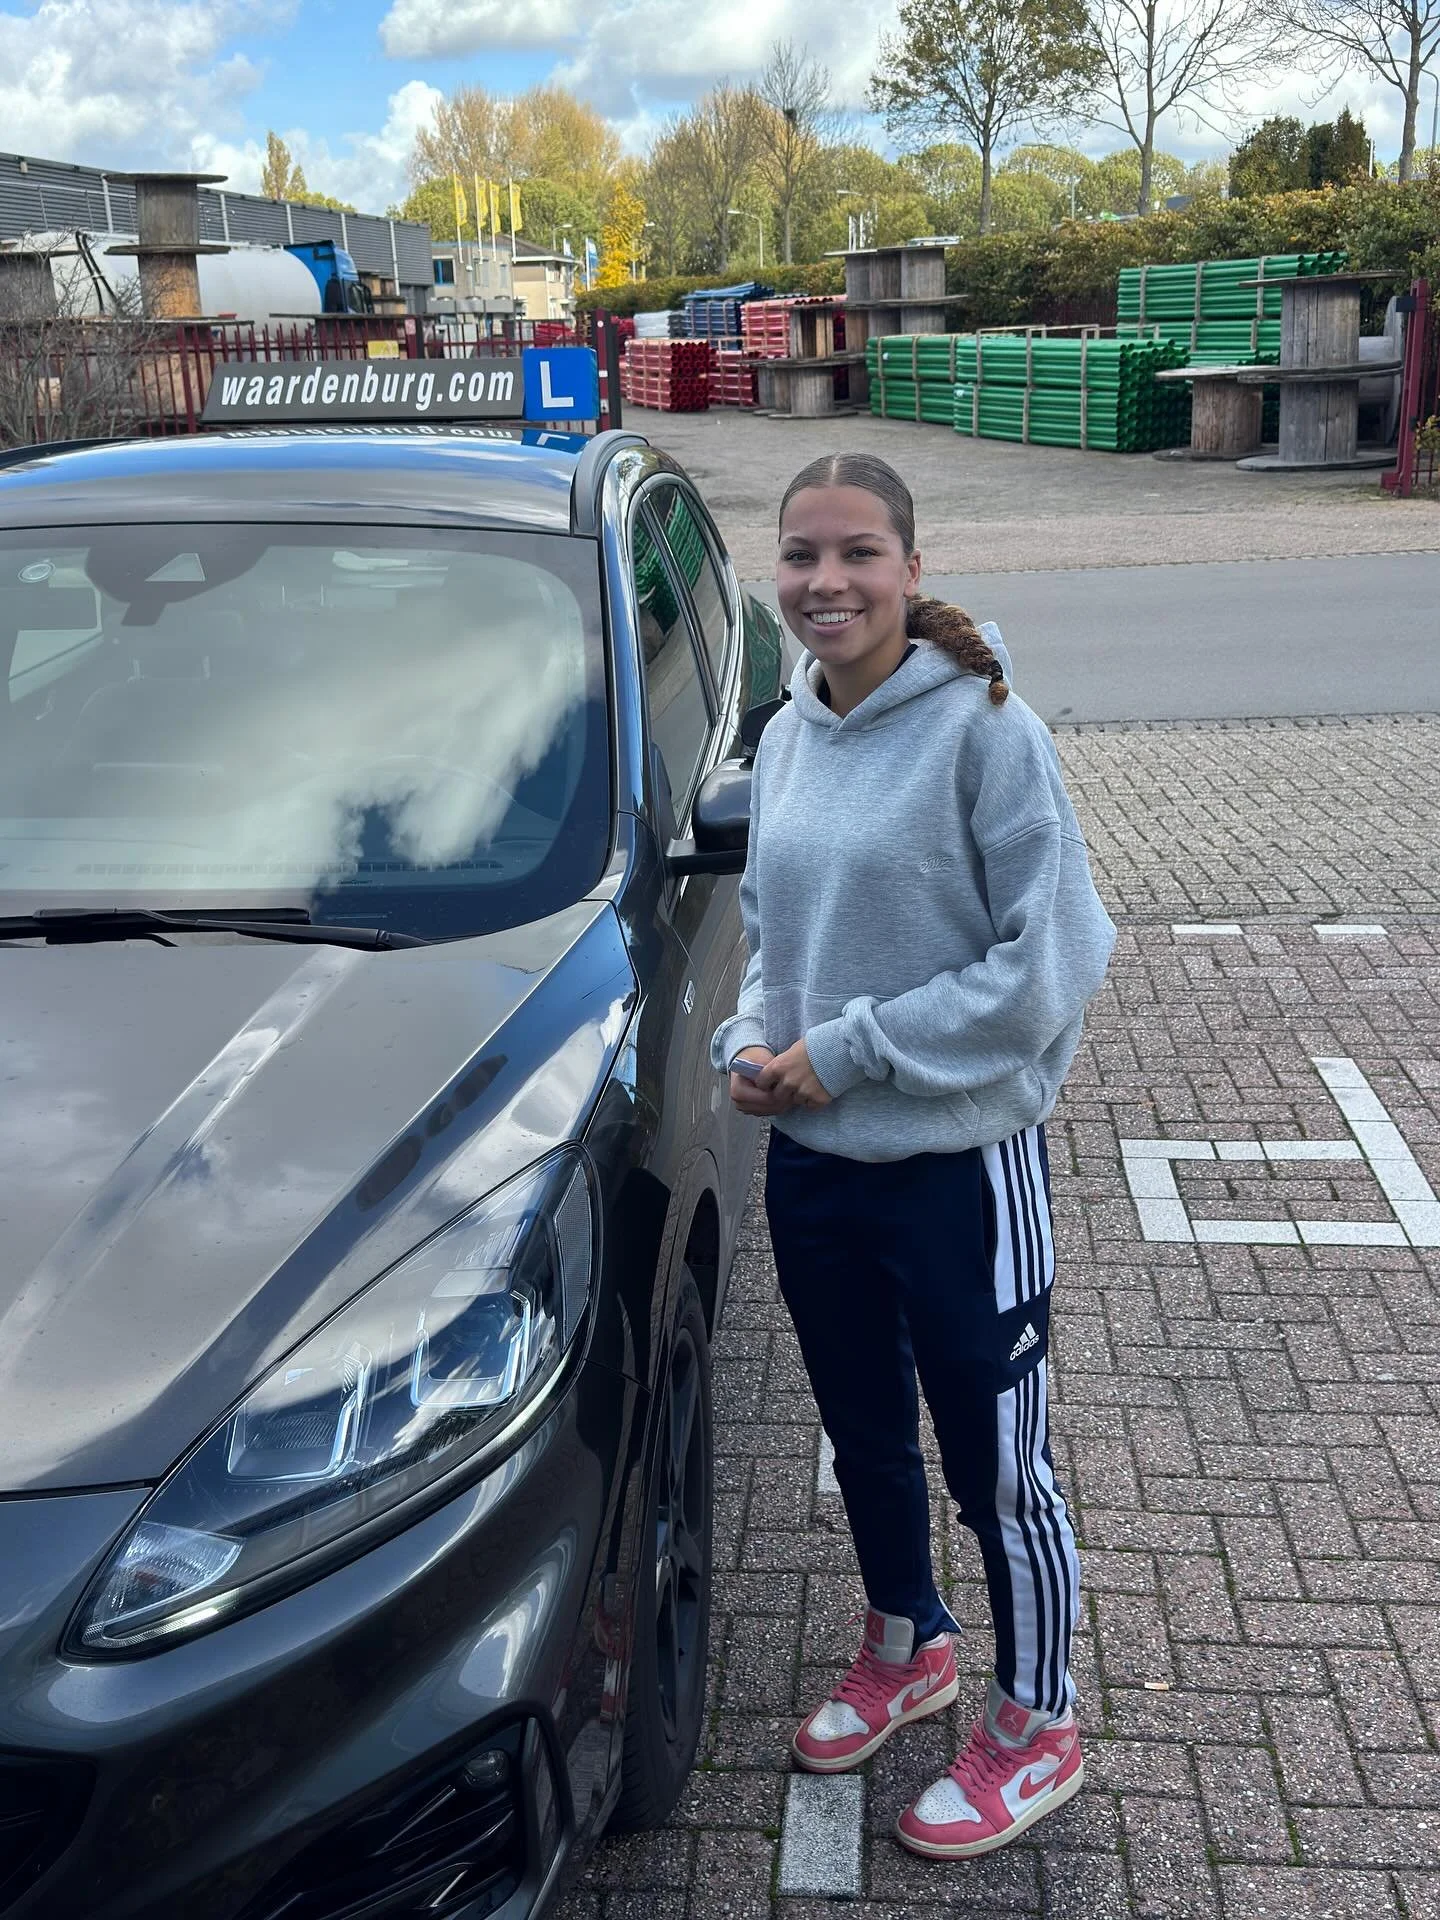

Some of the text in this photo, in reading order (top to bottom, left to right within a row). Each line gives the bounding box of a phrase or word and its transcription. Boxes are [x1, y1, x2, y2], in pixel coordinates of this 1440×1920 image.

[221, 366, 514, 411] waardenburg.com
[540, 361, 575, 408] L
[1010, 1335, 1040, 1361] adidas
